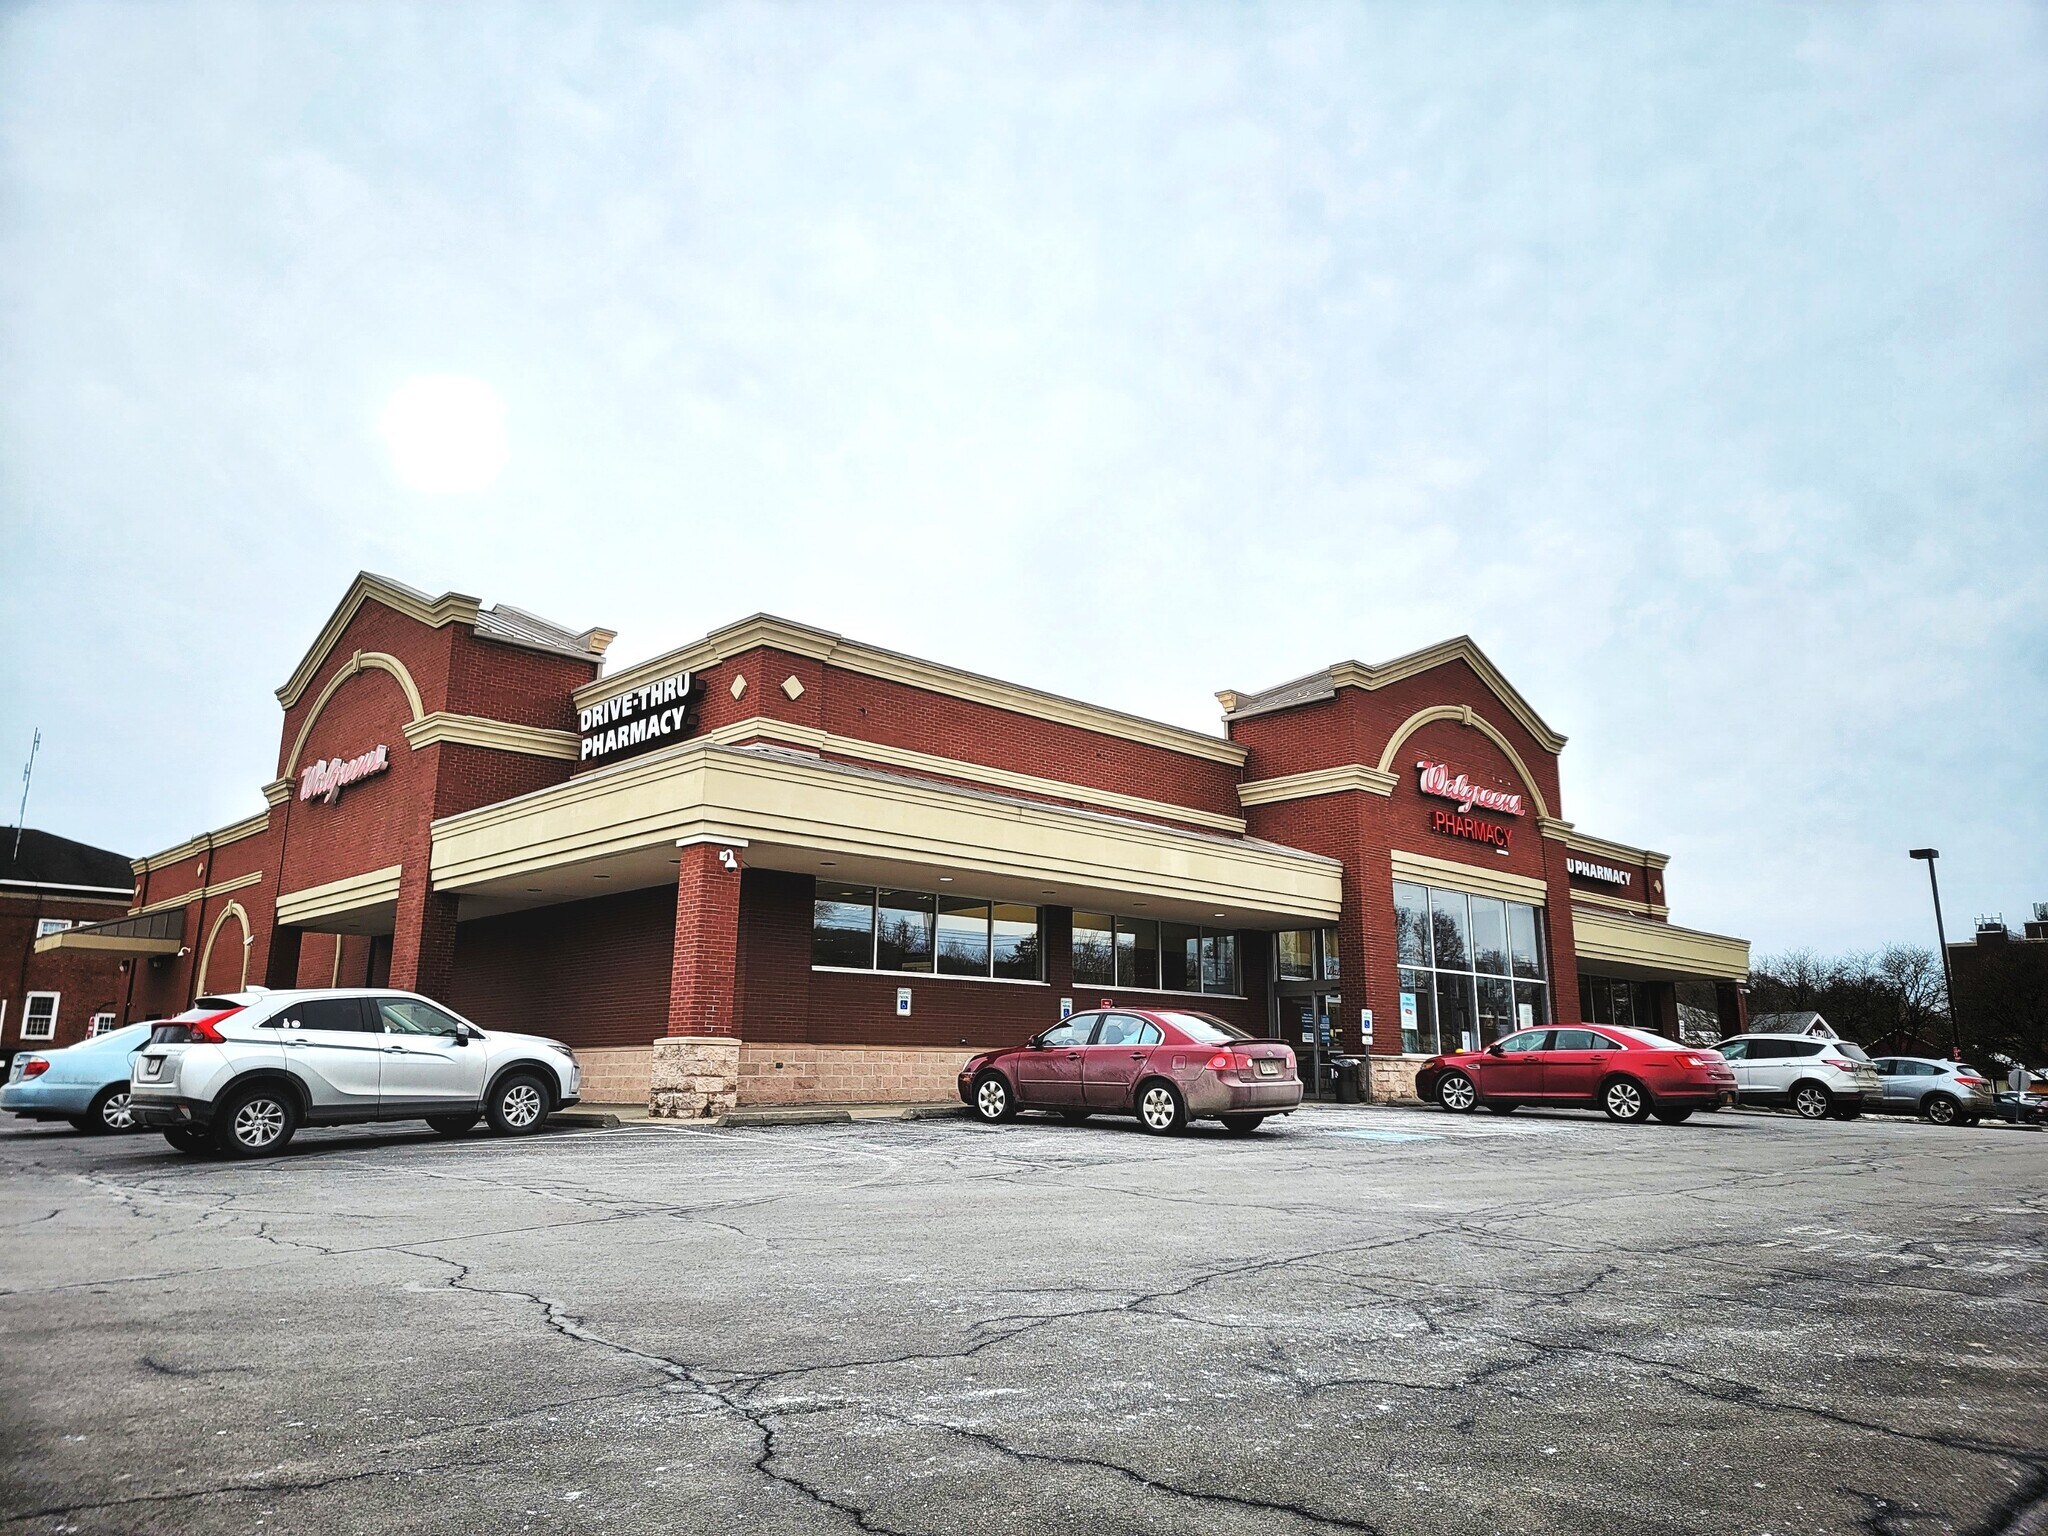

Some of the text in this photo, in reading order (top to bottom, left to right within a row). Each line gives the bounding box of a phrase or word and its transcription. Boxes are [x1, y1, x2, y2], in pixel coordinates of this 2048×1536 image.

[581, 672, 690, 732] DRIVE-THRU
[581, 705, 686, 761] PHARMACY
[1417, 760, 1526, 816] Walgreens
[1434, 811, 1512, 847] PHARMACY
